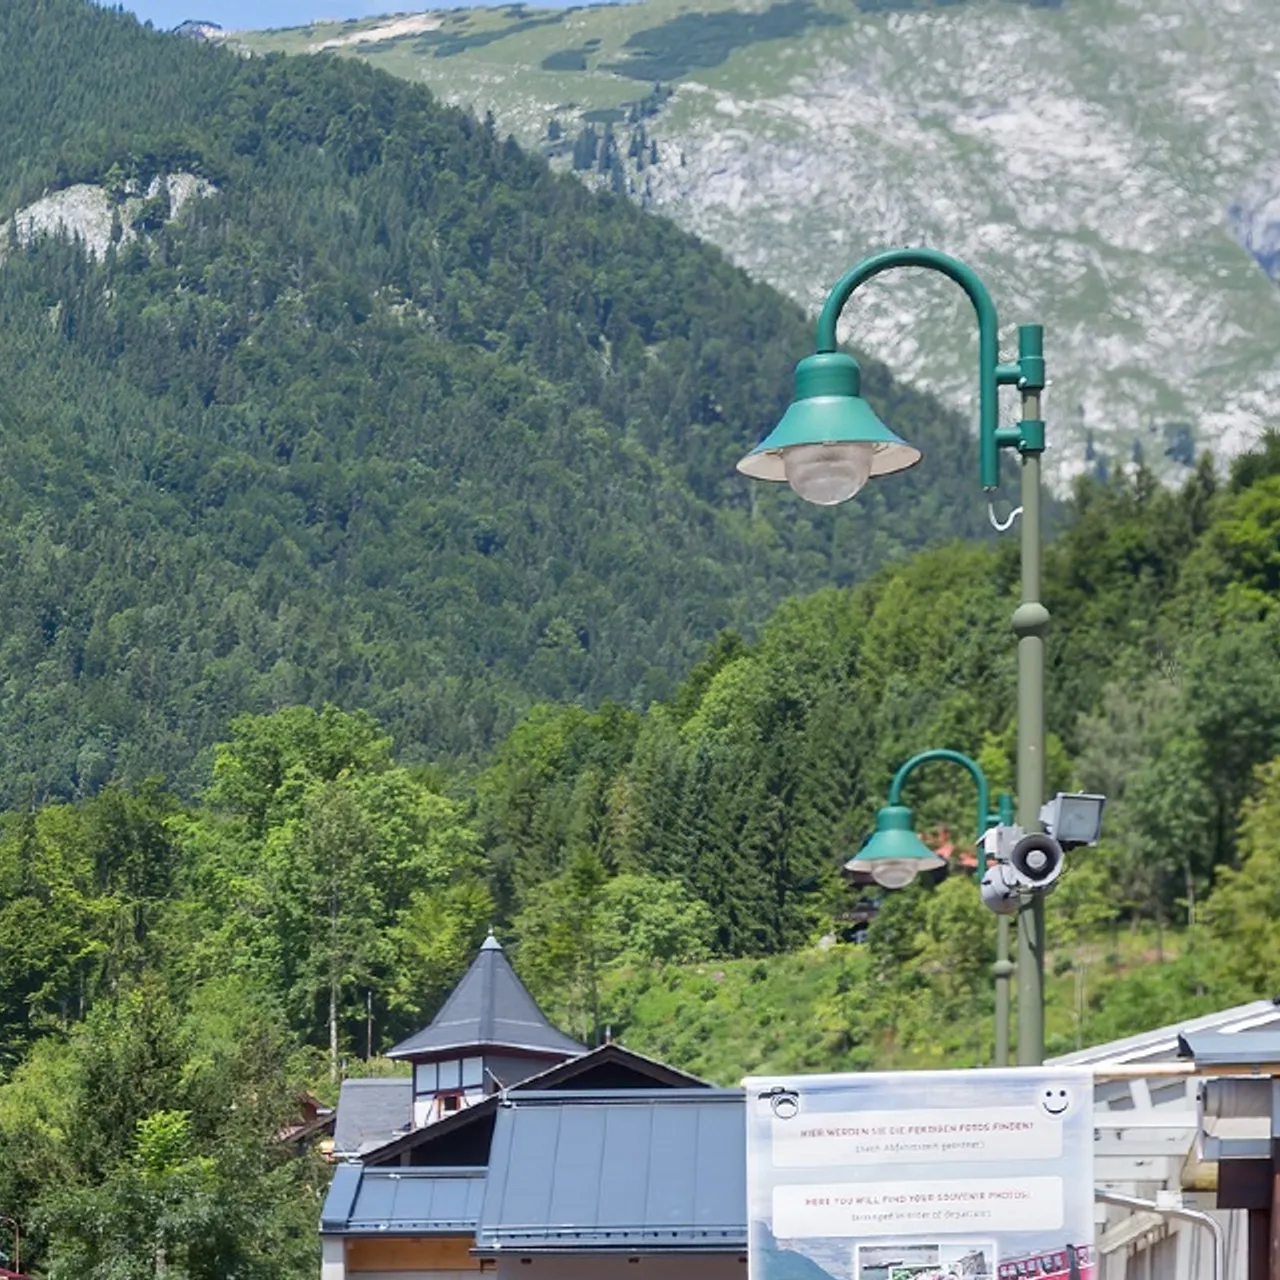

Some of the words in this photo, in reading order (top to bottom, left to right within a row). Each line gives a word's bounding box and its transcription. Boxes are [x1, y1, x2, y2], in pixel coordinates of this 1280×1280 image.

[800, 1128, 824, 1137] HIER
[827, 1127, 869, 1137] WERDEN
[959, 1122, 989, 1133] FOTOS
[805, 1197, 830, 1207] HERE
[834, 1196, 853, 1206] YOU
[855, 1195, 880, 1205] WILL
[882, 1194, 907, 1204] FIND
[937, 1191, 985, 1202] SOUVENIR
